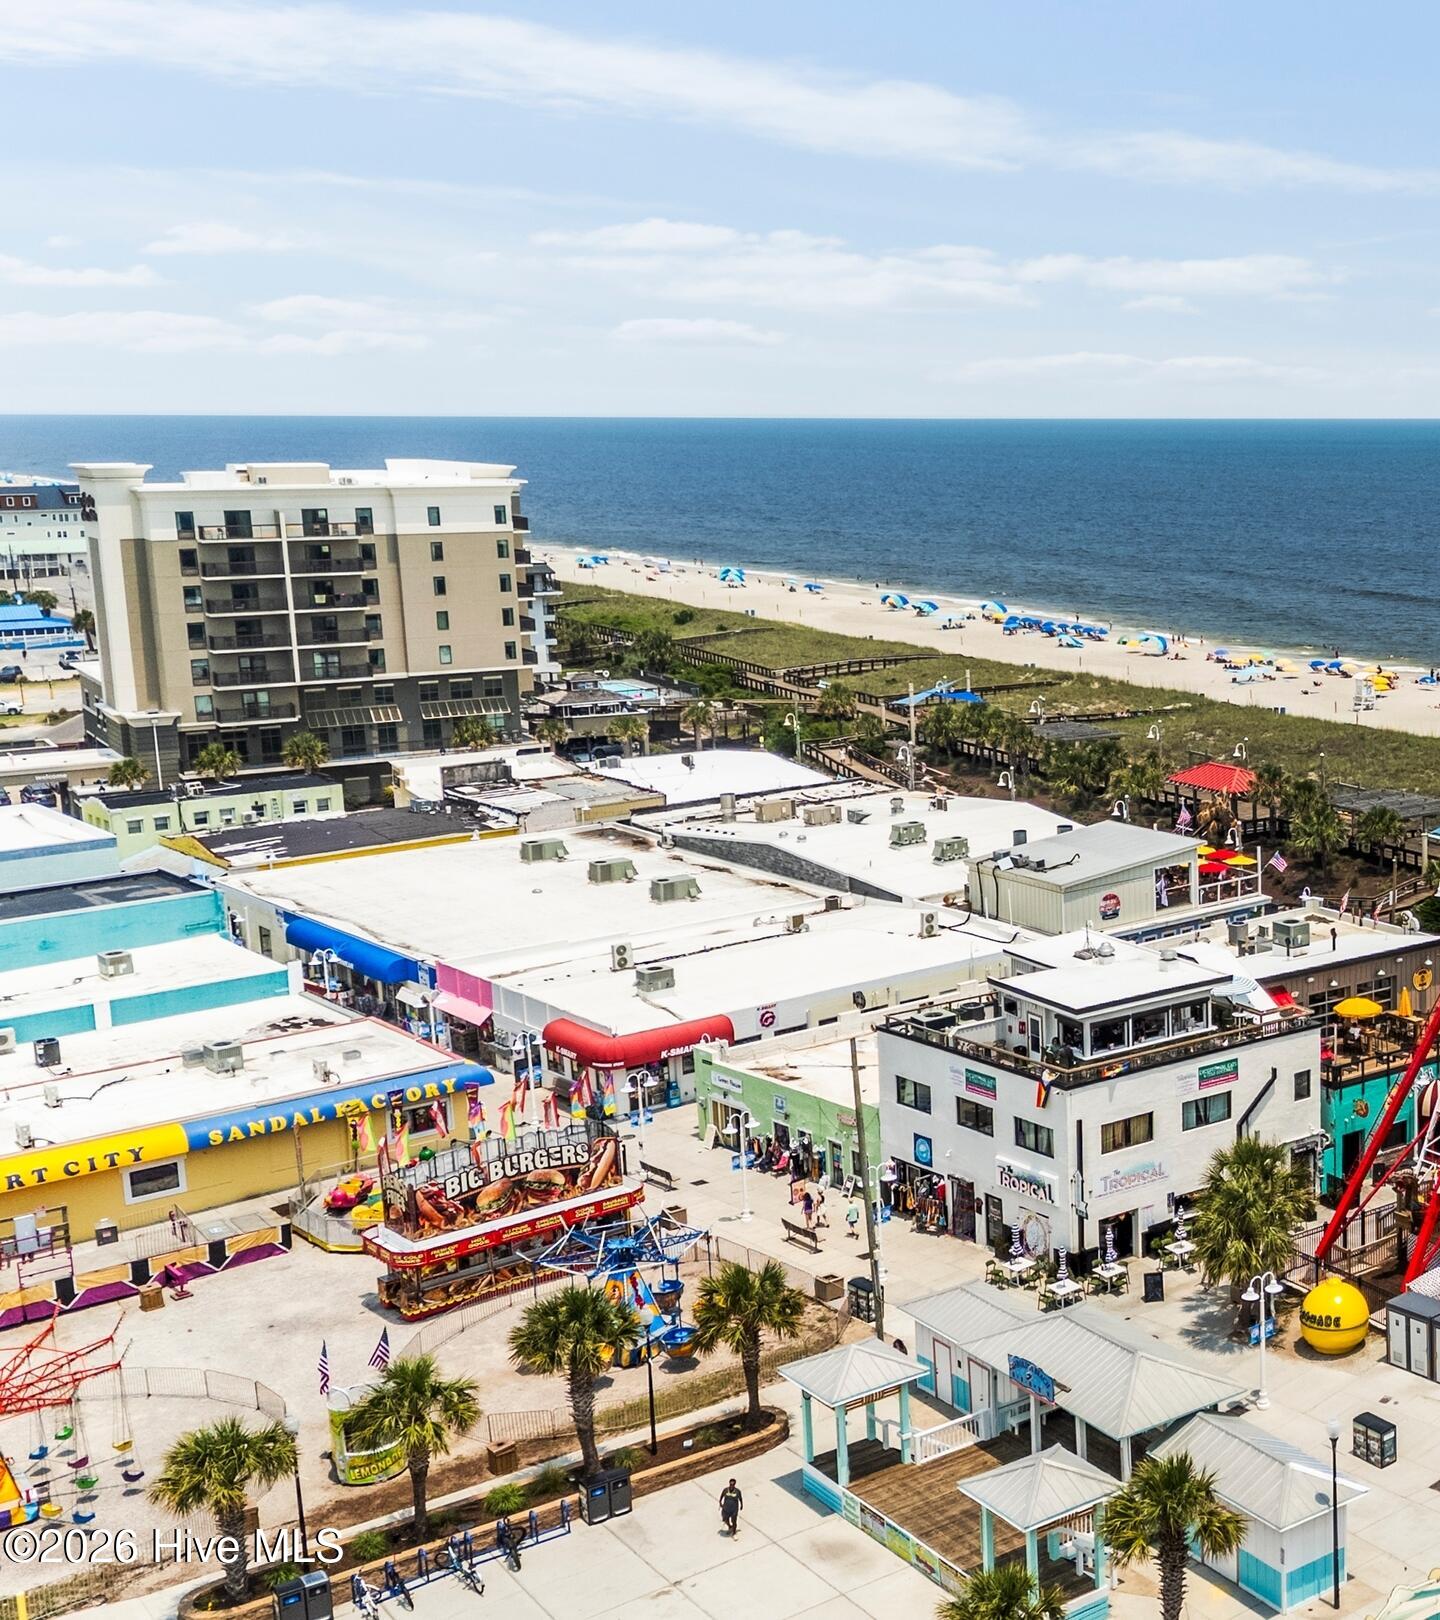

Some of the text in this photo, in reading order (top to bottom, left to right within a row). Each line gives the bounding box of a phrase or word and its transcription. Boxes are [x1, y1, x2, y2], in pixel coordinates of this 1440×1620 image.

[35, 773, 68, 781] welcome
[208, 1077, 458, 1146] SANDAL FACORY
[63, 1146, 145, 1177] CITY
[445, 1143, 591, 1200] BIG BURGERS
[1100, 1161, 1165, 1192] TROPICAL
[996, 1165, 1055, 1204] TROPICAL
[468, 1240, 490, 1249] DOGS
[471, 1236, 486, 1244] HOT
[350, 1447, 404, 1480] LEMONADE
